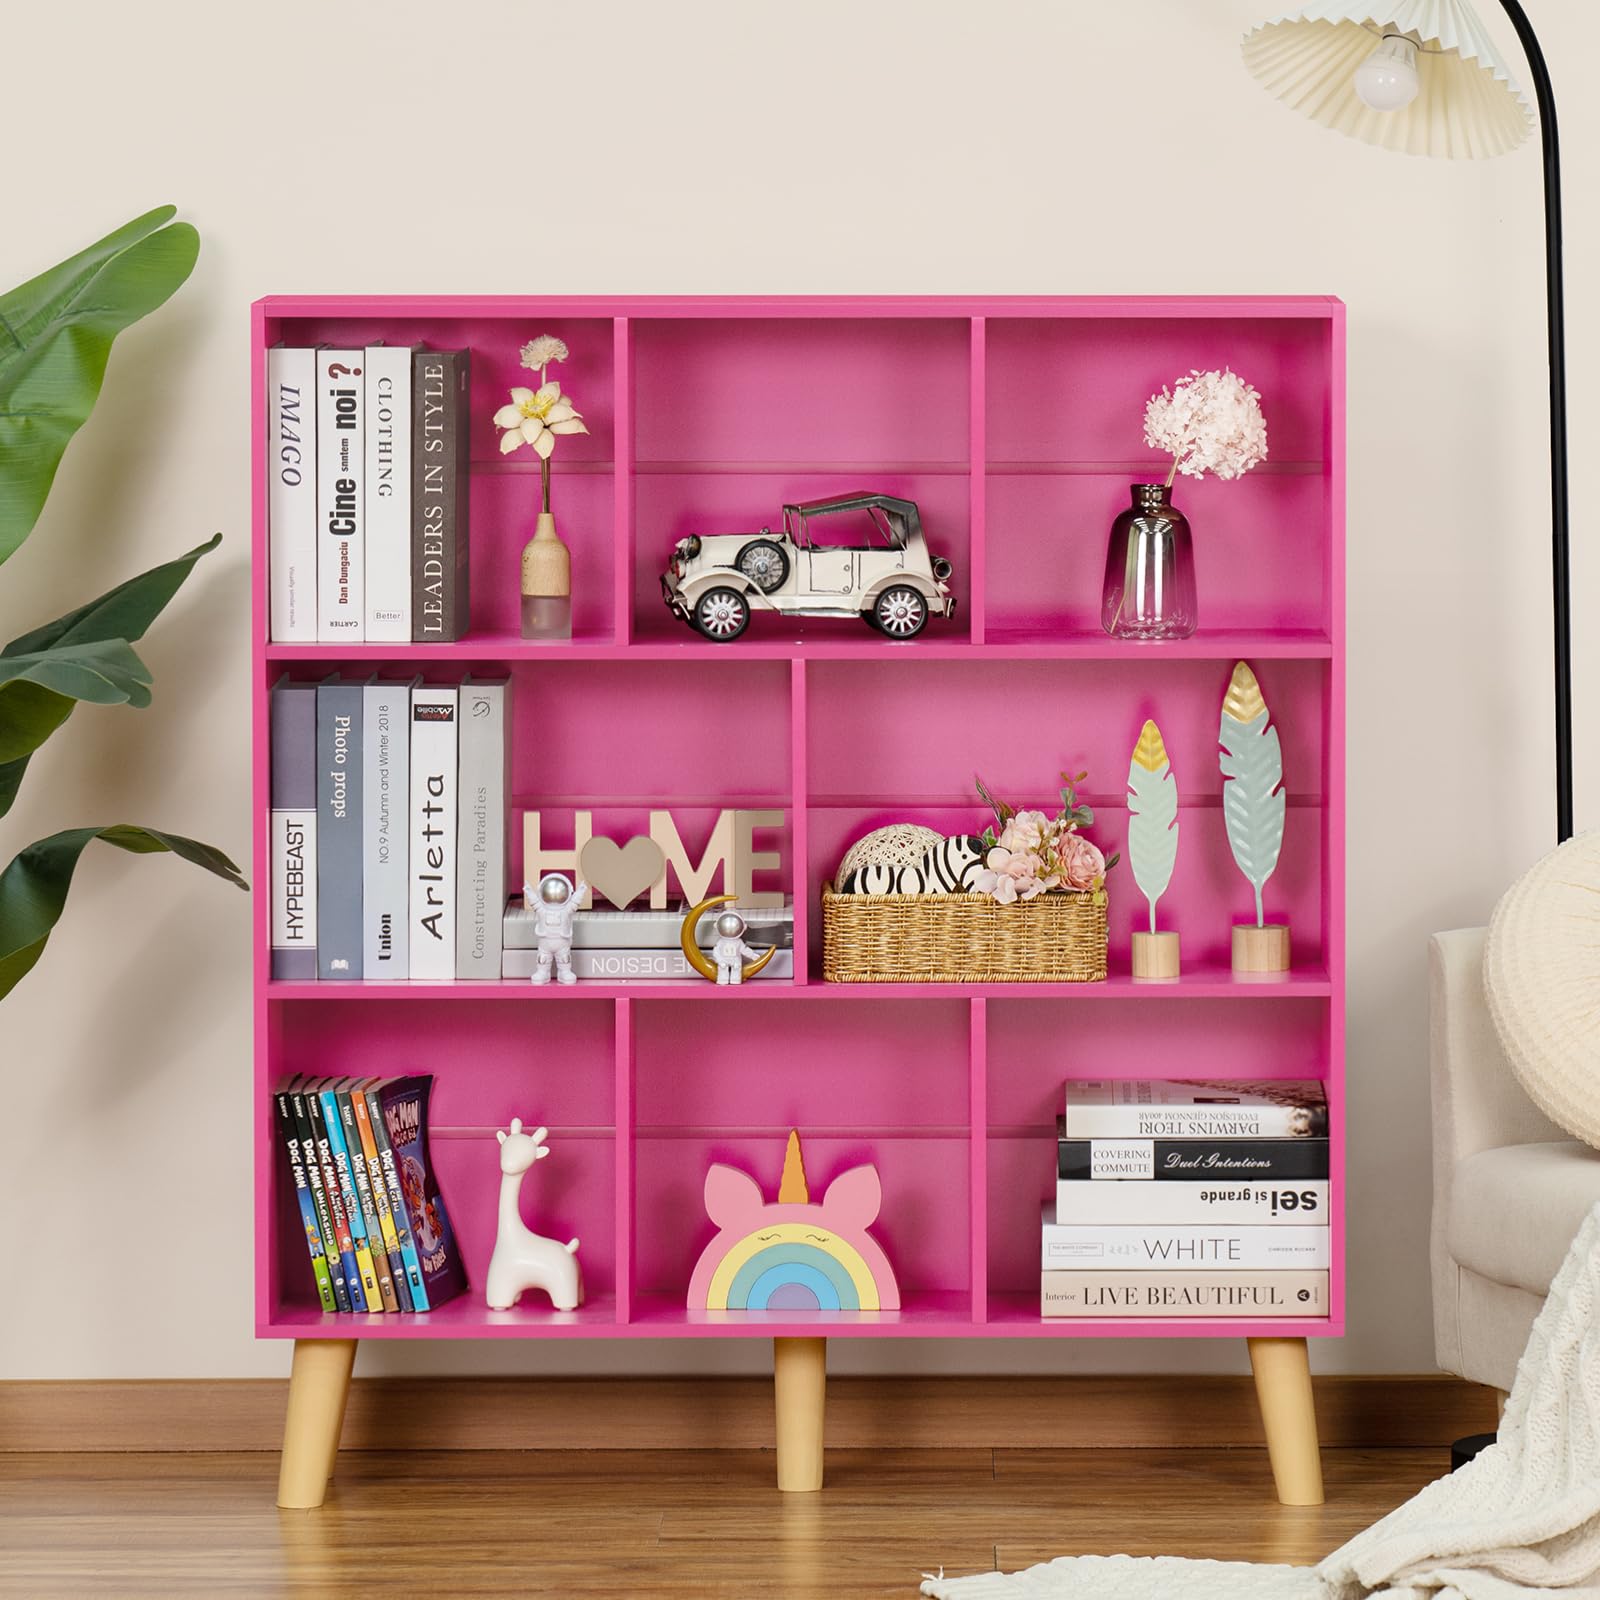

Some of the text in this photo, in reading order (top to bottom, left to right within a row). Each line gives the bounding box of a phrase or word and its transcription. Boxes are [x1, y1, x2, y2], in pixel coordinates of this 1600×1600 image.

[328, 363, 362, 379] ?
[329, 390, 357, 430] noi
[280, 384, 302, 486] IMAGO
[378, 378, 392, 497] CLOTHING
[329, 479, 356, 536] Cine
[424, 365, 442, 633] LEADERS IN STYLE
[339, 542, 349, 584] Dungaciu
[339, 587, 348, 604] Dan
[376, 612, 400, 620] Better
[332, 716, 350, 818] Photo props
[379, 705, 389, 863] NO.9 Autumn and Winter 2018
[419, 776, 444, 940] Arletta
[287, 819, 303, 940] HYPEBEAST
[472, 788, 486, 959] Constructing Paradies
[379, 914, 391, 960] Union
[1139, 1122, 1259, 1134] DARWINS TEORI
[303, 1139, 316, 1163] DOG
[380, 1149, 394, 1169] DOG
[1093, 1150, 1151, 1159] COVERING
[288, 1139, 307, 1188] DOG MAN
[318, 1139, 337, 1188] DOG MAN
[335, 1152, 348, 1172] DOG
[352, 1153, 365, 1172] DOG
[367, 1157, 381, 1176] DOG
[1093, 1163, 1150, 1173] COMMUTE
[308, 1166, 322, 1188] MAN
[339, 1172, 352, 1193] MAN
[356, 1173, 369, 1191] MAN
[373, 1175, 385, 1193] MAN
[385, 1171, 399, 1189] MAN
[1201, 1189, 1317, 1216] sei si grande
[1144, 1240, 1240, 1259] WHITE
[1046, 1292, 1076, 1300] Interior
[1084, 1287, 1283, 1304] LIVE BEAUTIFUL
